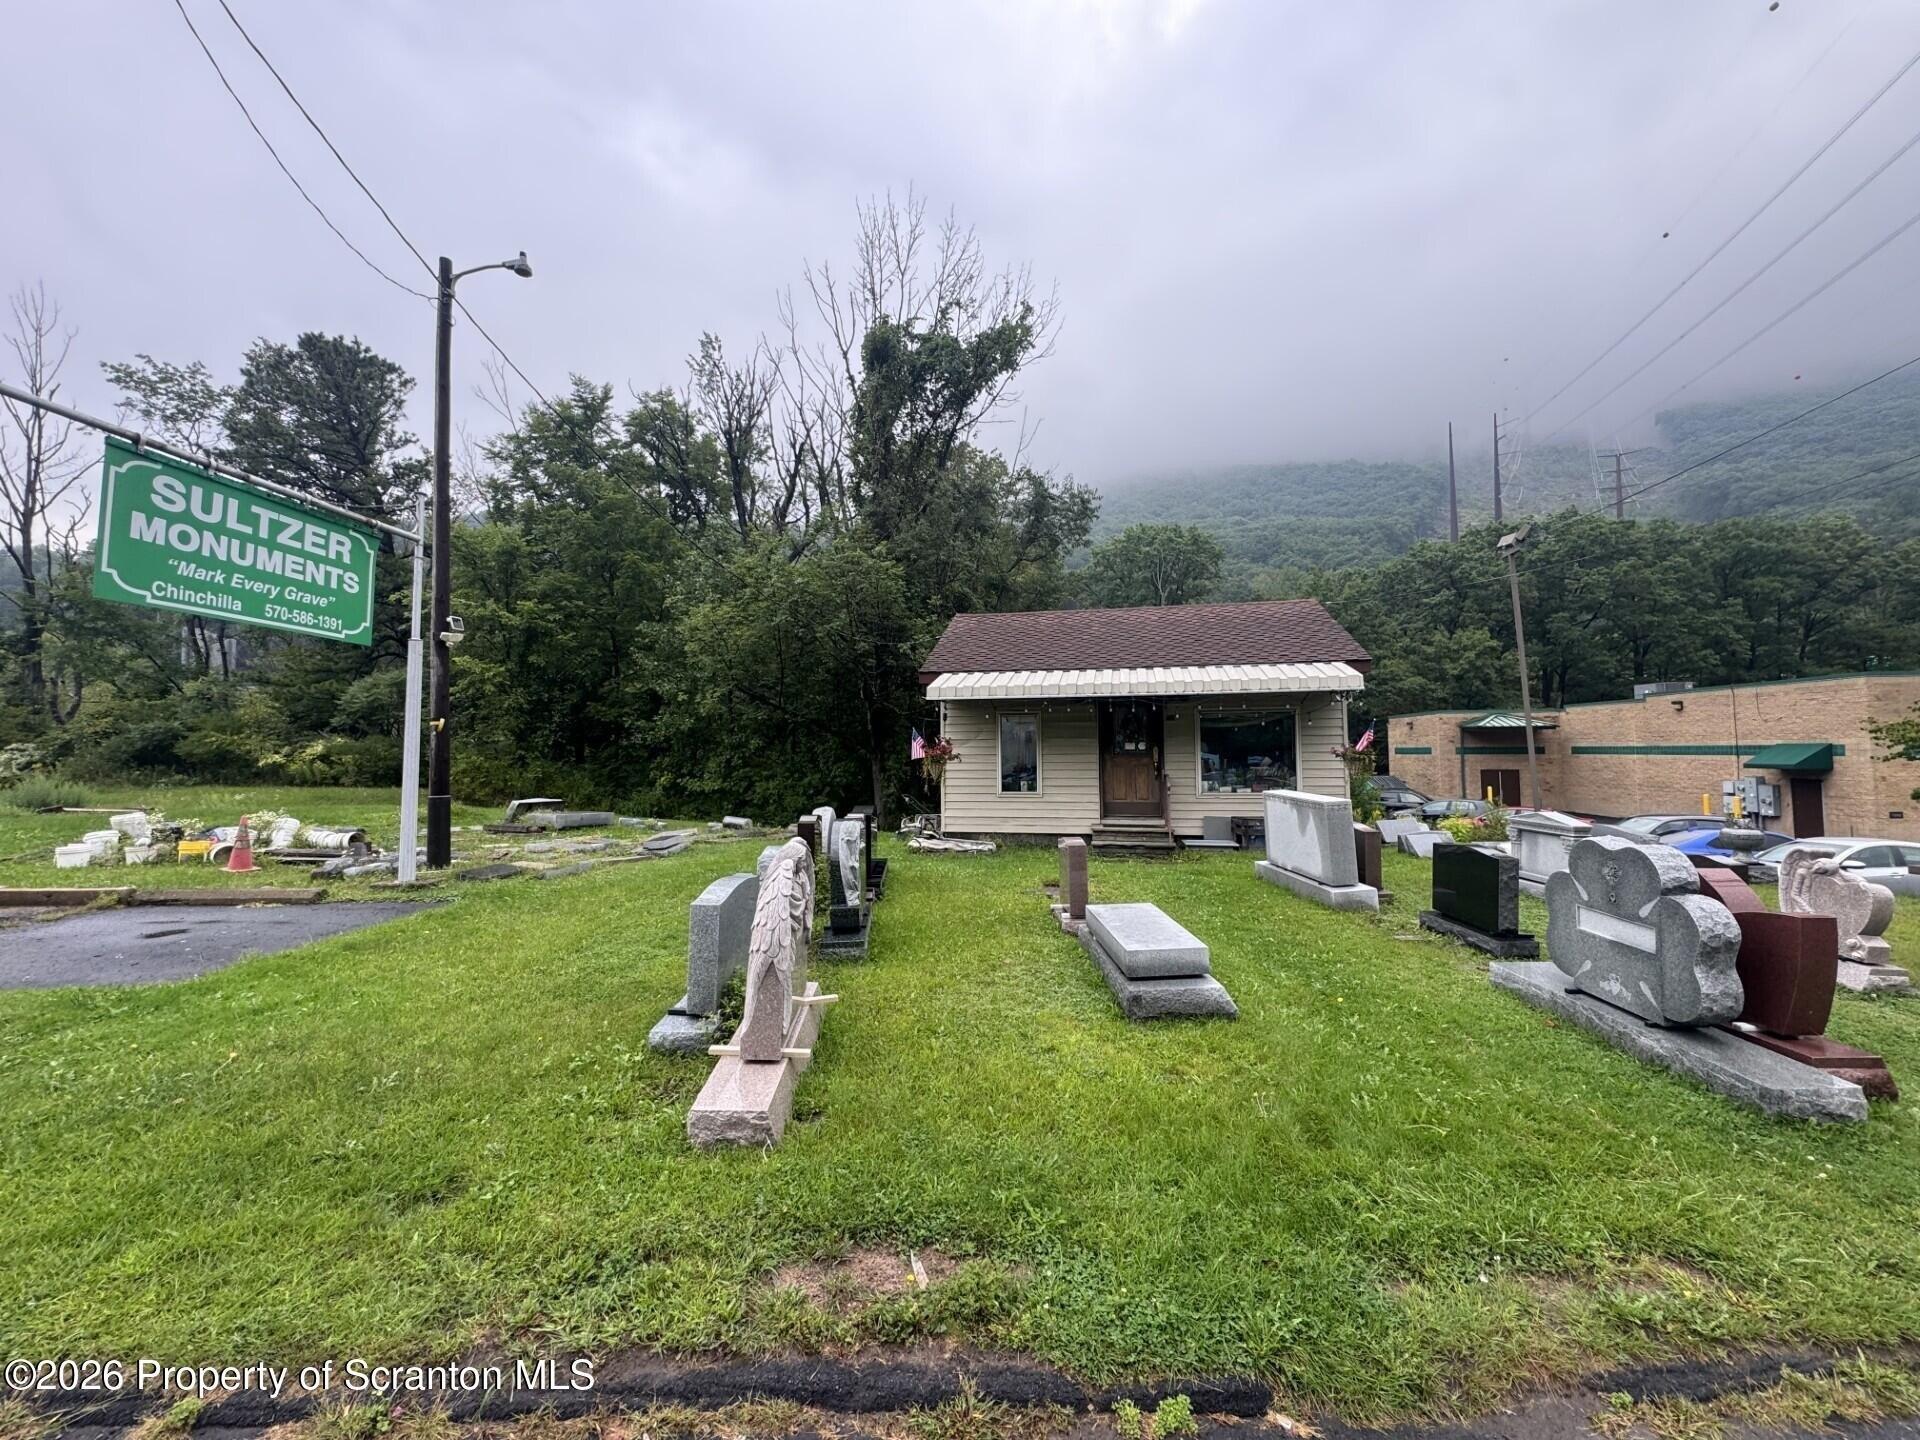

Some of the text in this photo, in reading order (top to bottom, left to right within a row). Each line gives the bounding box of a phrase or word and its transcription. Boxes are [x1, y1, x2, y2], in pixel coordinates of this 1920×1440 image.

[150, 475, 352, 564] SULTZER
[129, 510, 360, 594] MONUMENTS
[151, 580, 242, 612] Chinchilla
[230, 576, 281, 597] Every
[264, 603, 343, 632] 570-586-1391
